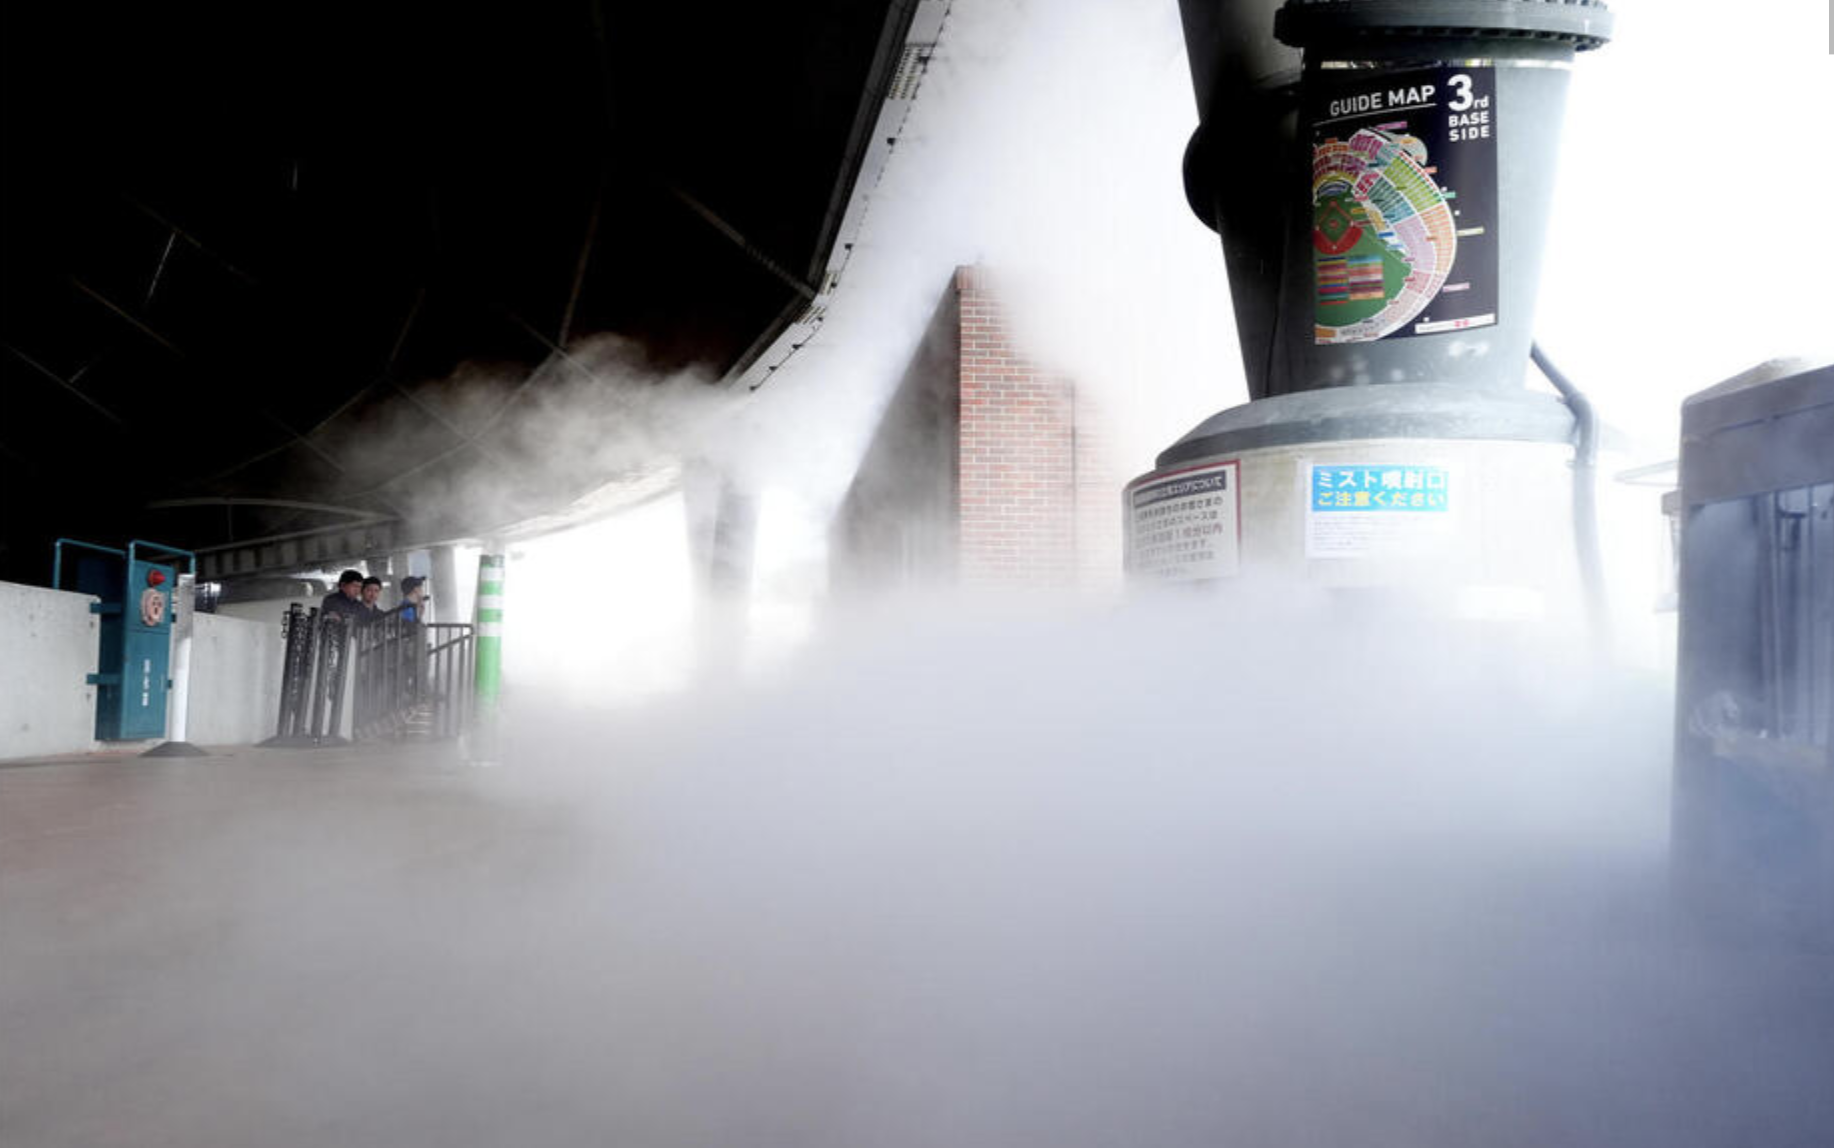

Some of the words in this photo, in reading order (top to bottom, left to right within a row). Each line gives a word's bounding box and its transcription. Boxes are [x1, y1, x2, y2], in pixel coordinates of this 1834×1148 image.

[1330, 92, 1383, 117] GUIDE
[1388, 84, 1436, 106] MAP
[1447, 74, 1489, 112] 3rd
[1448, 111, 1489, 127] BASE
[1449, 126, 1489, 142] SIDE
[1318, 470, 1445, 489] ミスト噴射口
[1318, 491, 1445, 507] ご注意ください
